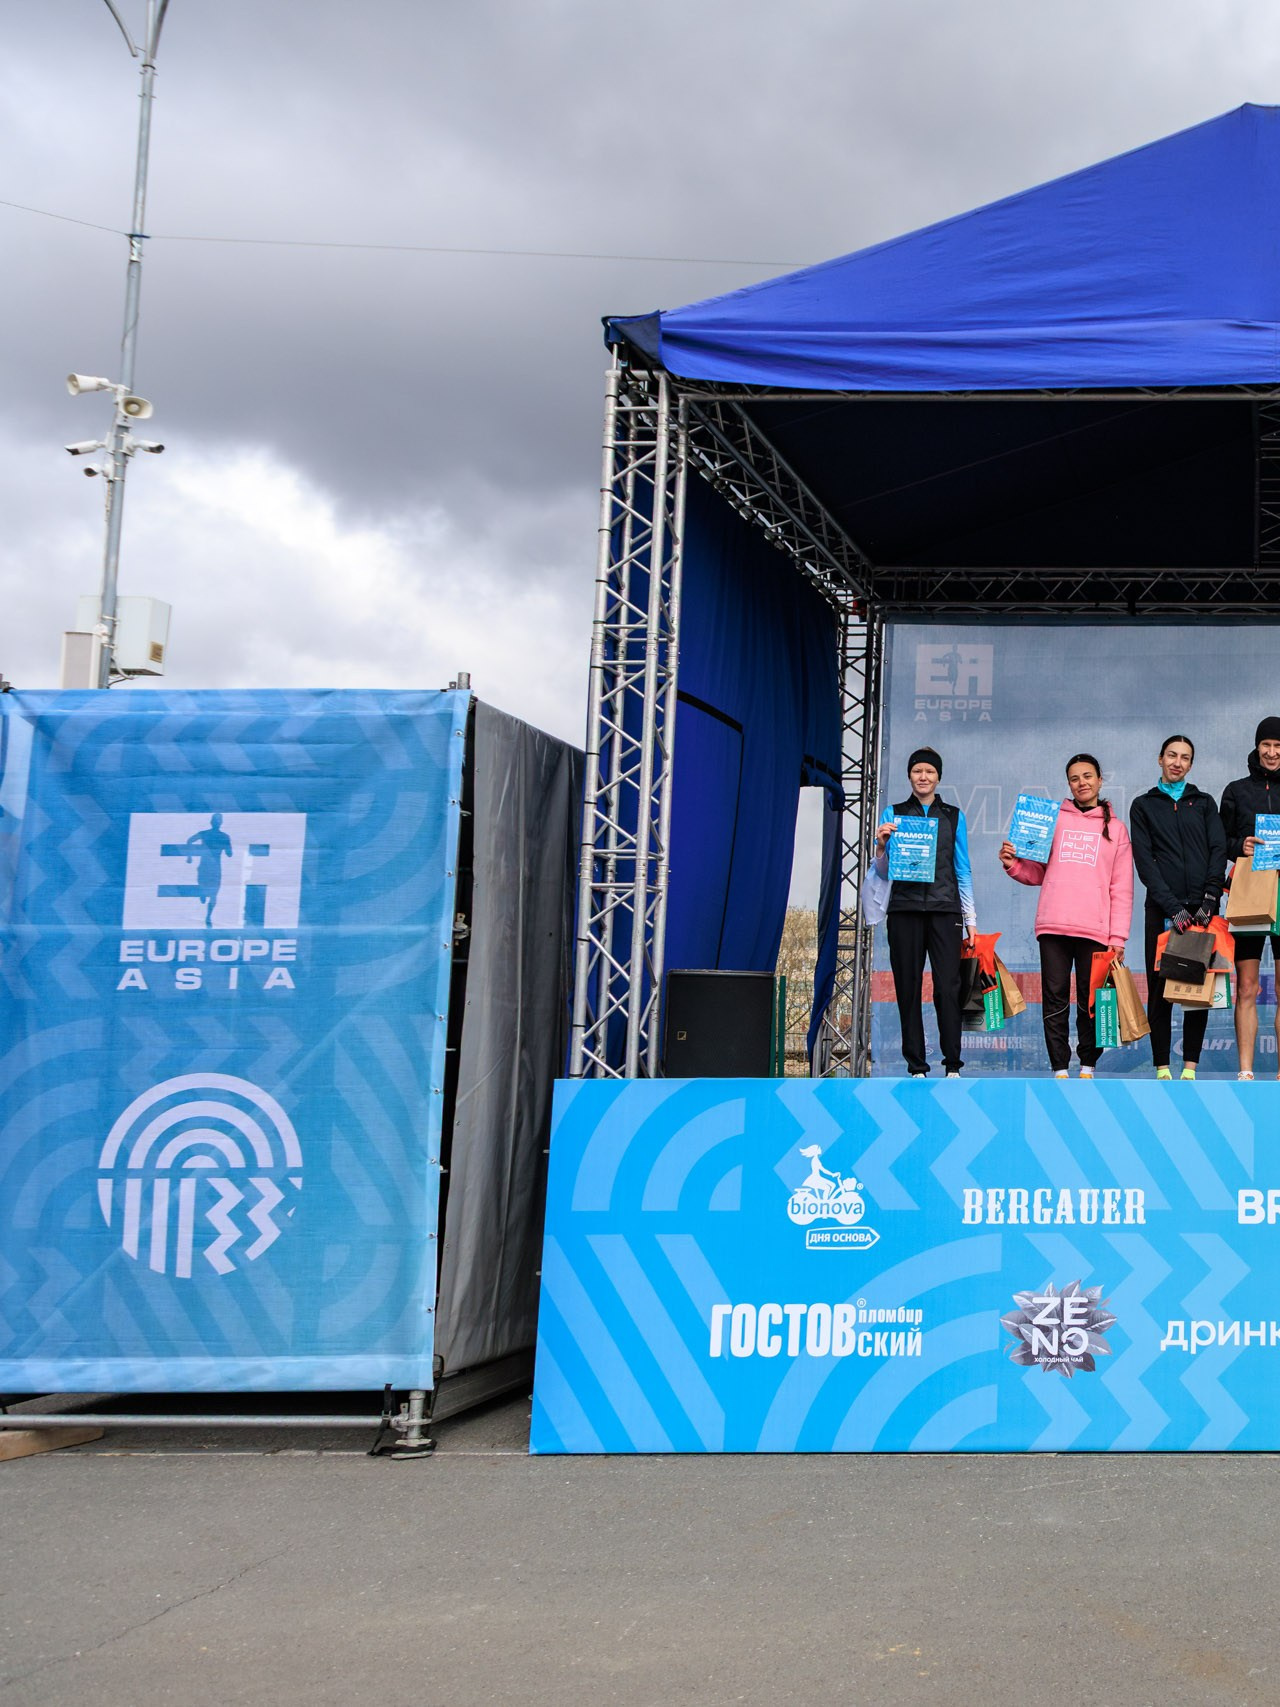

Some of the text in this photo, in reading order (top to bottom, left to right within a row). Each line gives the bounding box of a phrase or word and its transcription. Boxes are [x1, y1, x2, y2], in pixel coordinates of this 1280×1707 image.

[914, 700, 992, 710] EUROPE
[914, 711, 992, 722] ASIA
[1017, 809, 1054, 822] ГРАМОТА
[894, 831, 934, 840] ГРАМОТА
[1068, 833, 1094, 842] WE
[1063, 841, 1097, 853] RUN
[119, 939, 298, 963] EUROPE
[116, 965, 296, 991] ASIA
[961, 1036, 1023, 1049] BERGAUER
[1202, 1039, 1235, 1051] АНТ
[790, 1196, 863, 1215] bionova
[961, 1188, 1146, 1225] BERGAUER
[809, 1233, 872, 1244] ДНЯ ОСНОВА
[858, 1306, 923, 1325] пломбир
